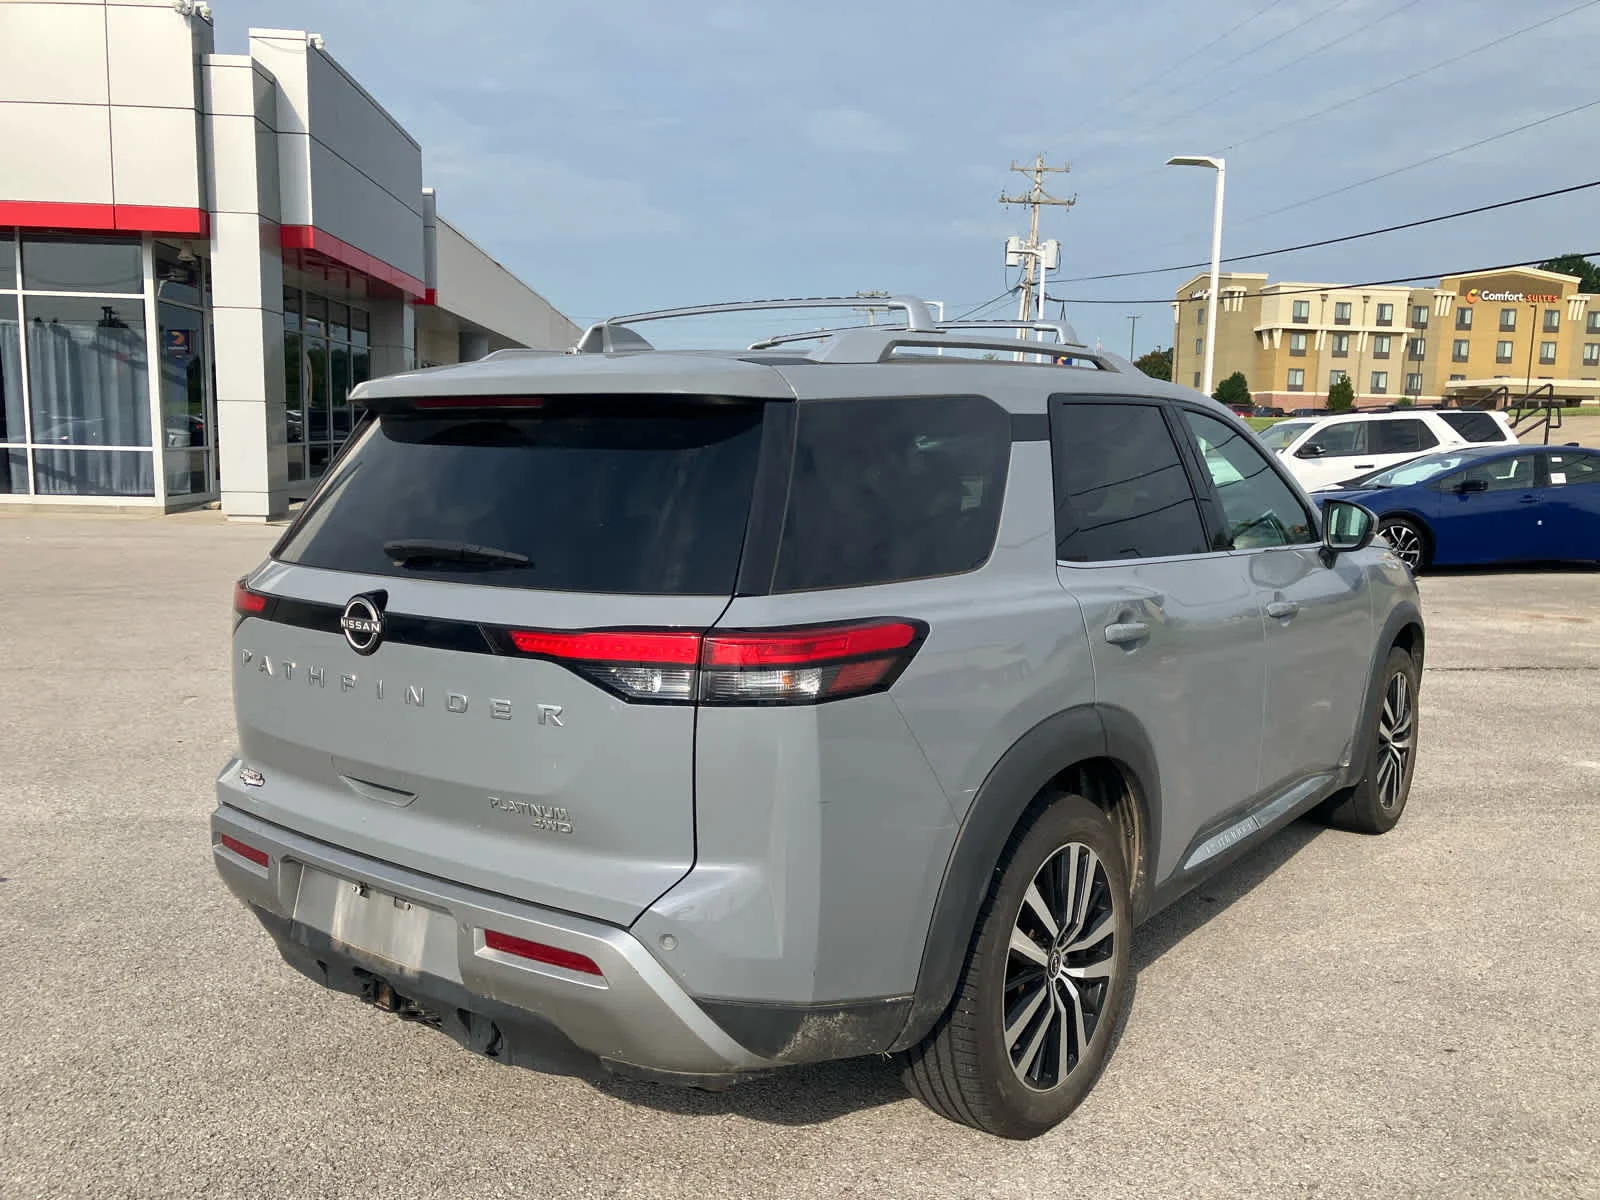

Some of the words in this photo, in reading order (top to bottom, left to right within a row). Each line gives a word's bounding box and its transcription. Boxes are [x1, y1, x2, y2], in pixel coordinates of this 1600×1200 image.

[1481, 290, 1523, 302] Comfort
[1526, 293, 1558, 303] SUITES
[340, 617, 380, 633] NISSAN
[241, 648, 565, 728] PATHFINDER
[488, 796, 569, 821] PLATINUM
